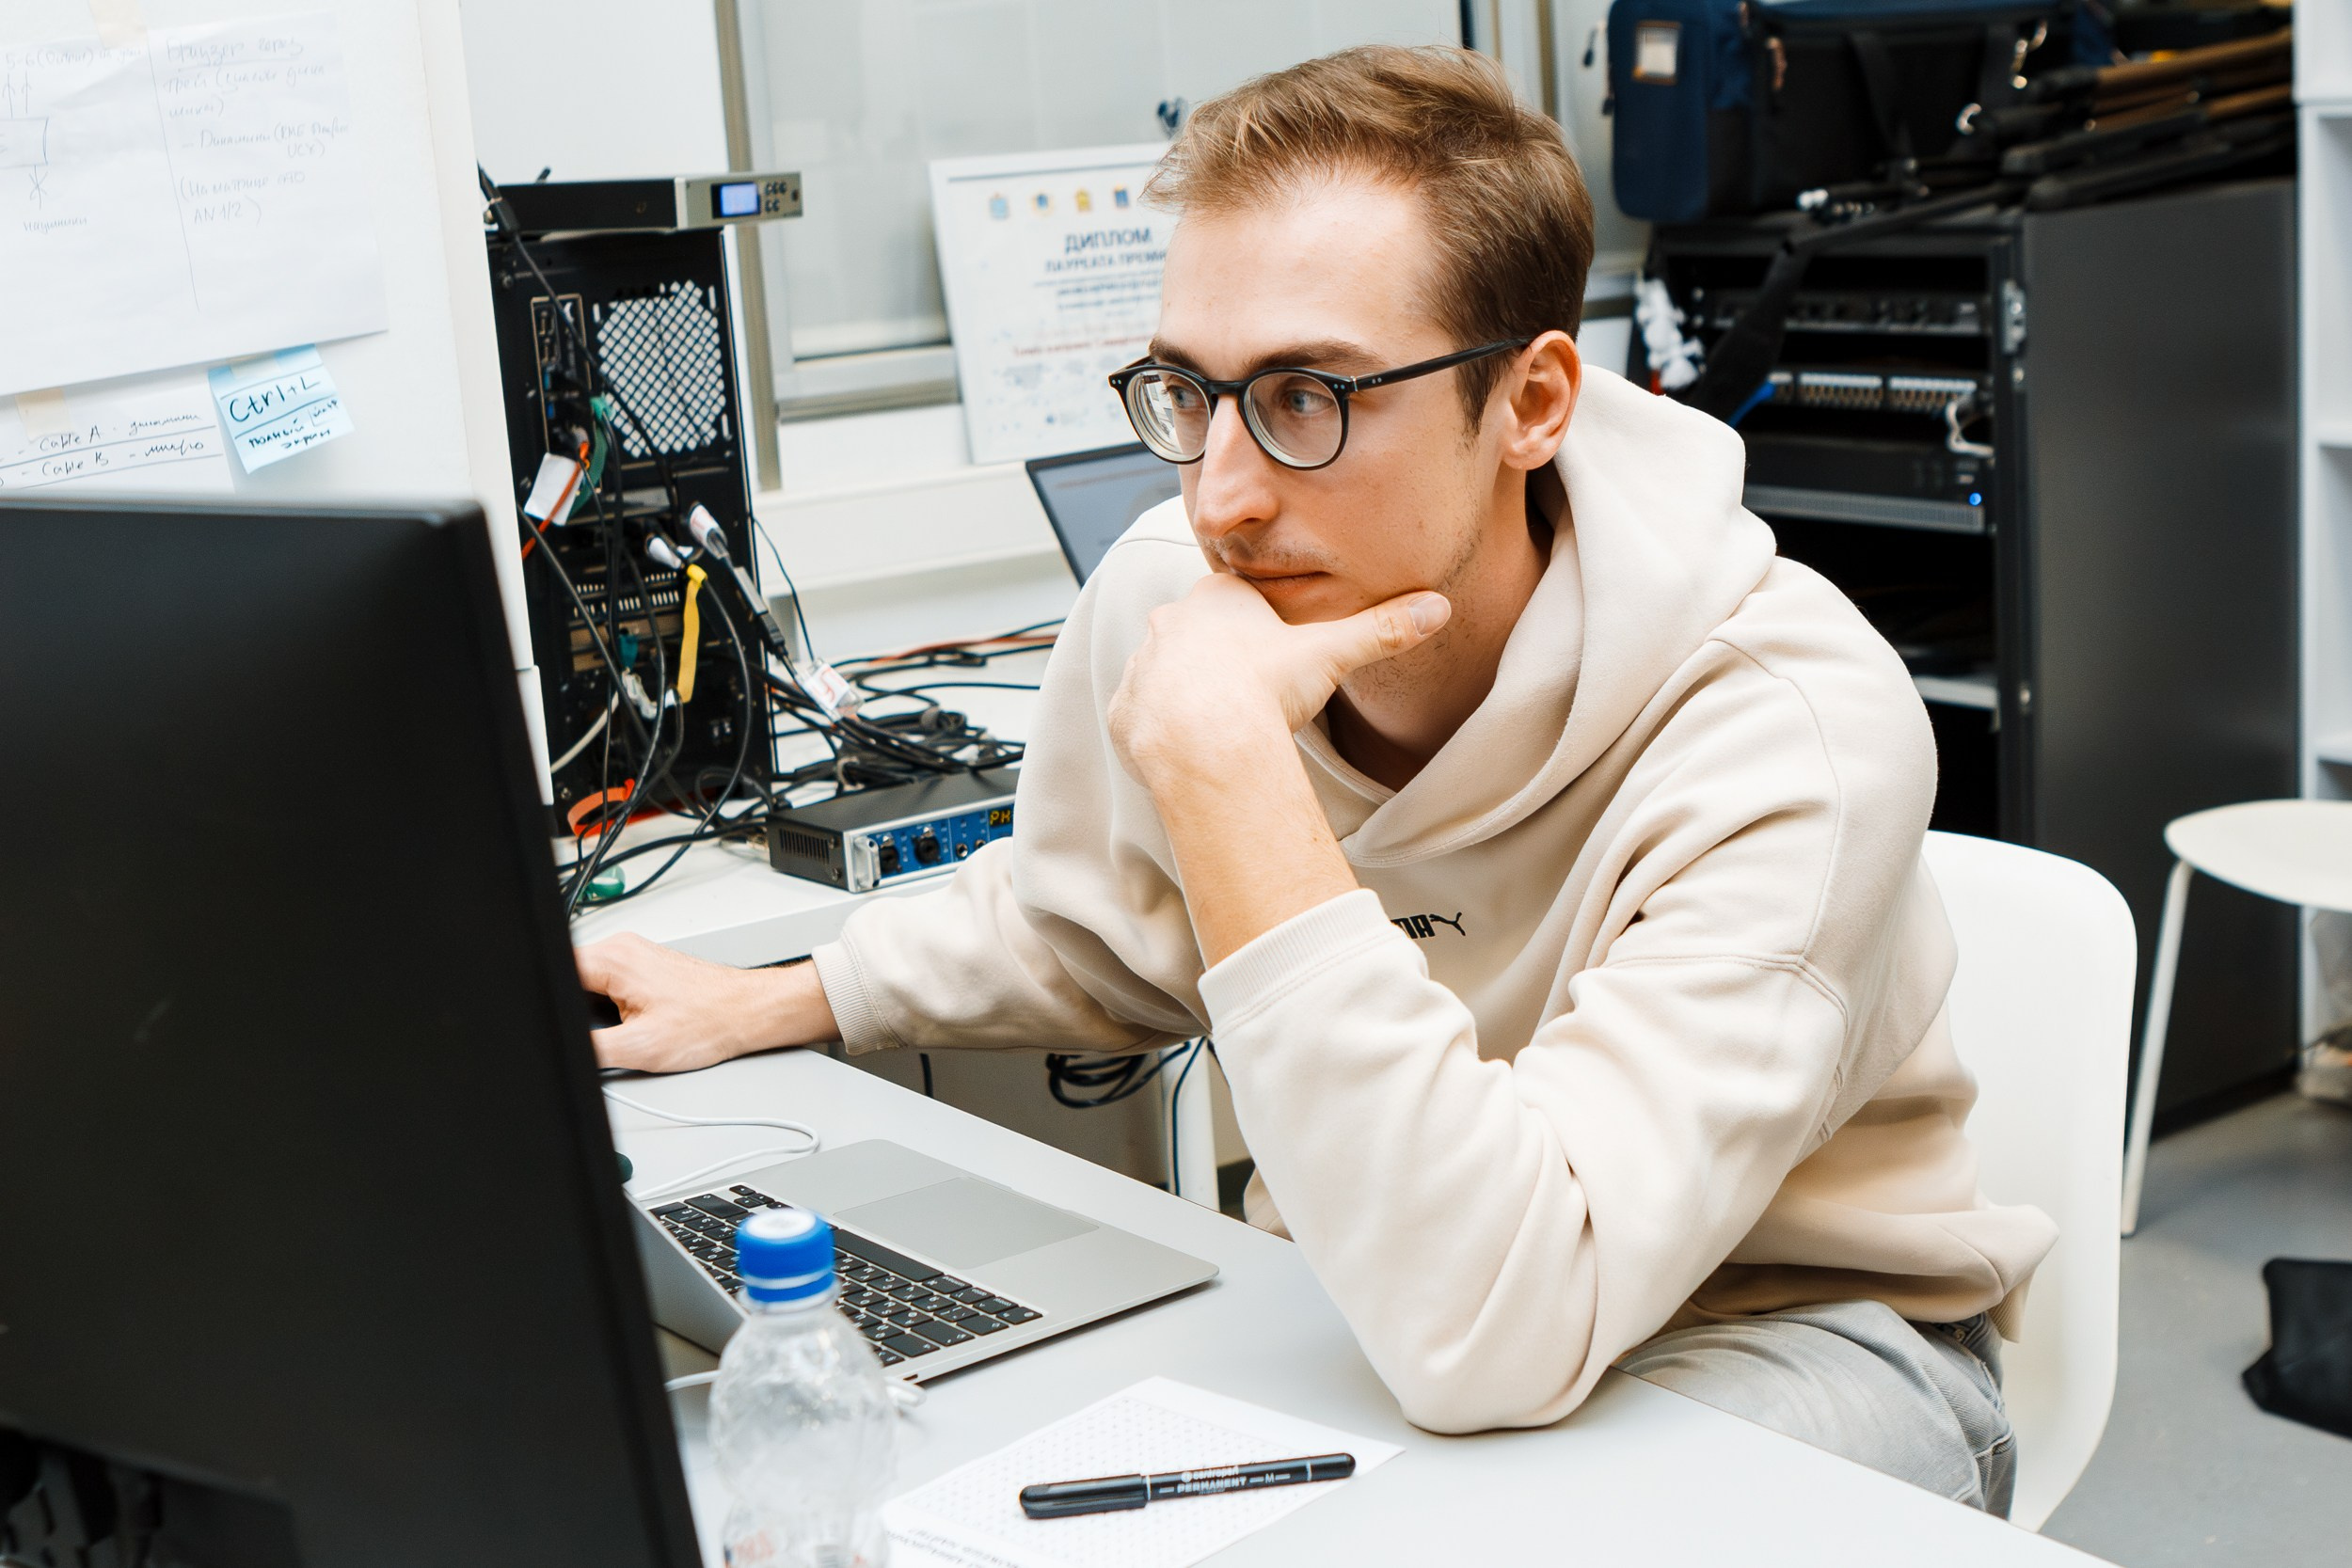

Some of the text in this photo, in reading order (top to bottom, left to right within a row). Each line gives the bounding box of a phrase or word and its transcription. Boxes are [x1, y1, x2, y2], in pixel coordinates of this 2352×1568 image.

[1064, 228, 1152, 253] ДИПЛОМ
[40, 433, 81, 451] Cable
[42, 460, 84, 477] Cable
[1177, 1475, 1248, 1494] PERMANENT
[1264, 1472, 1276, 1483] M
